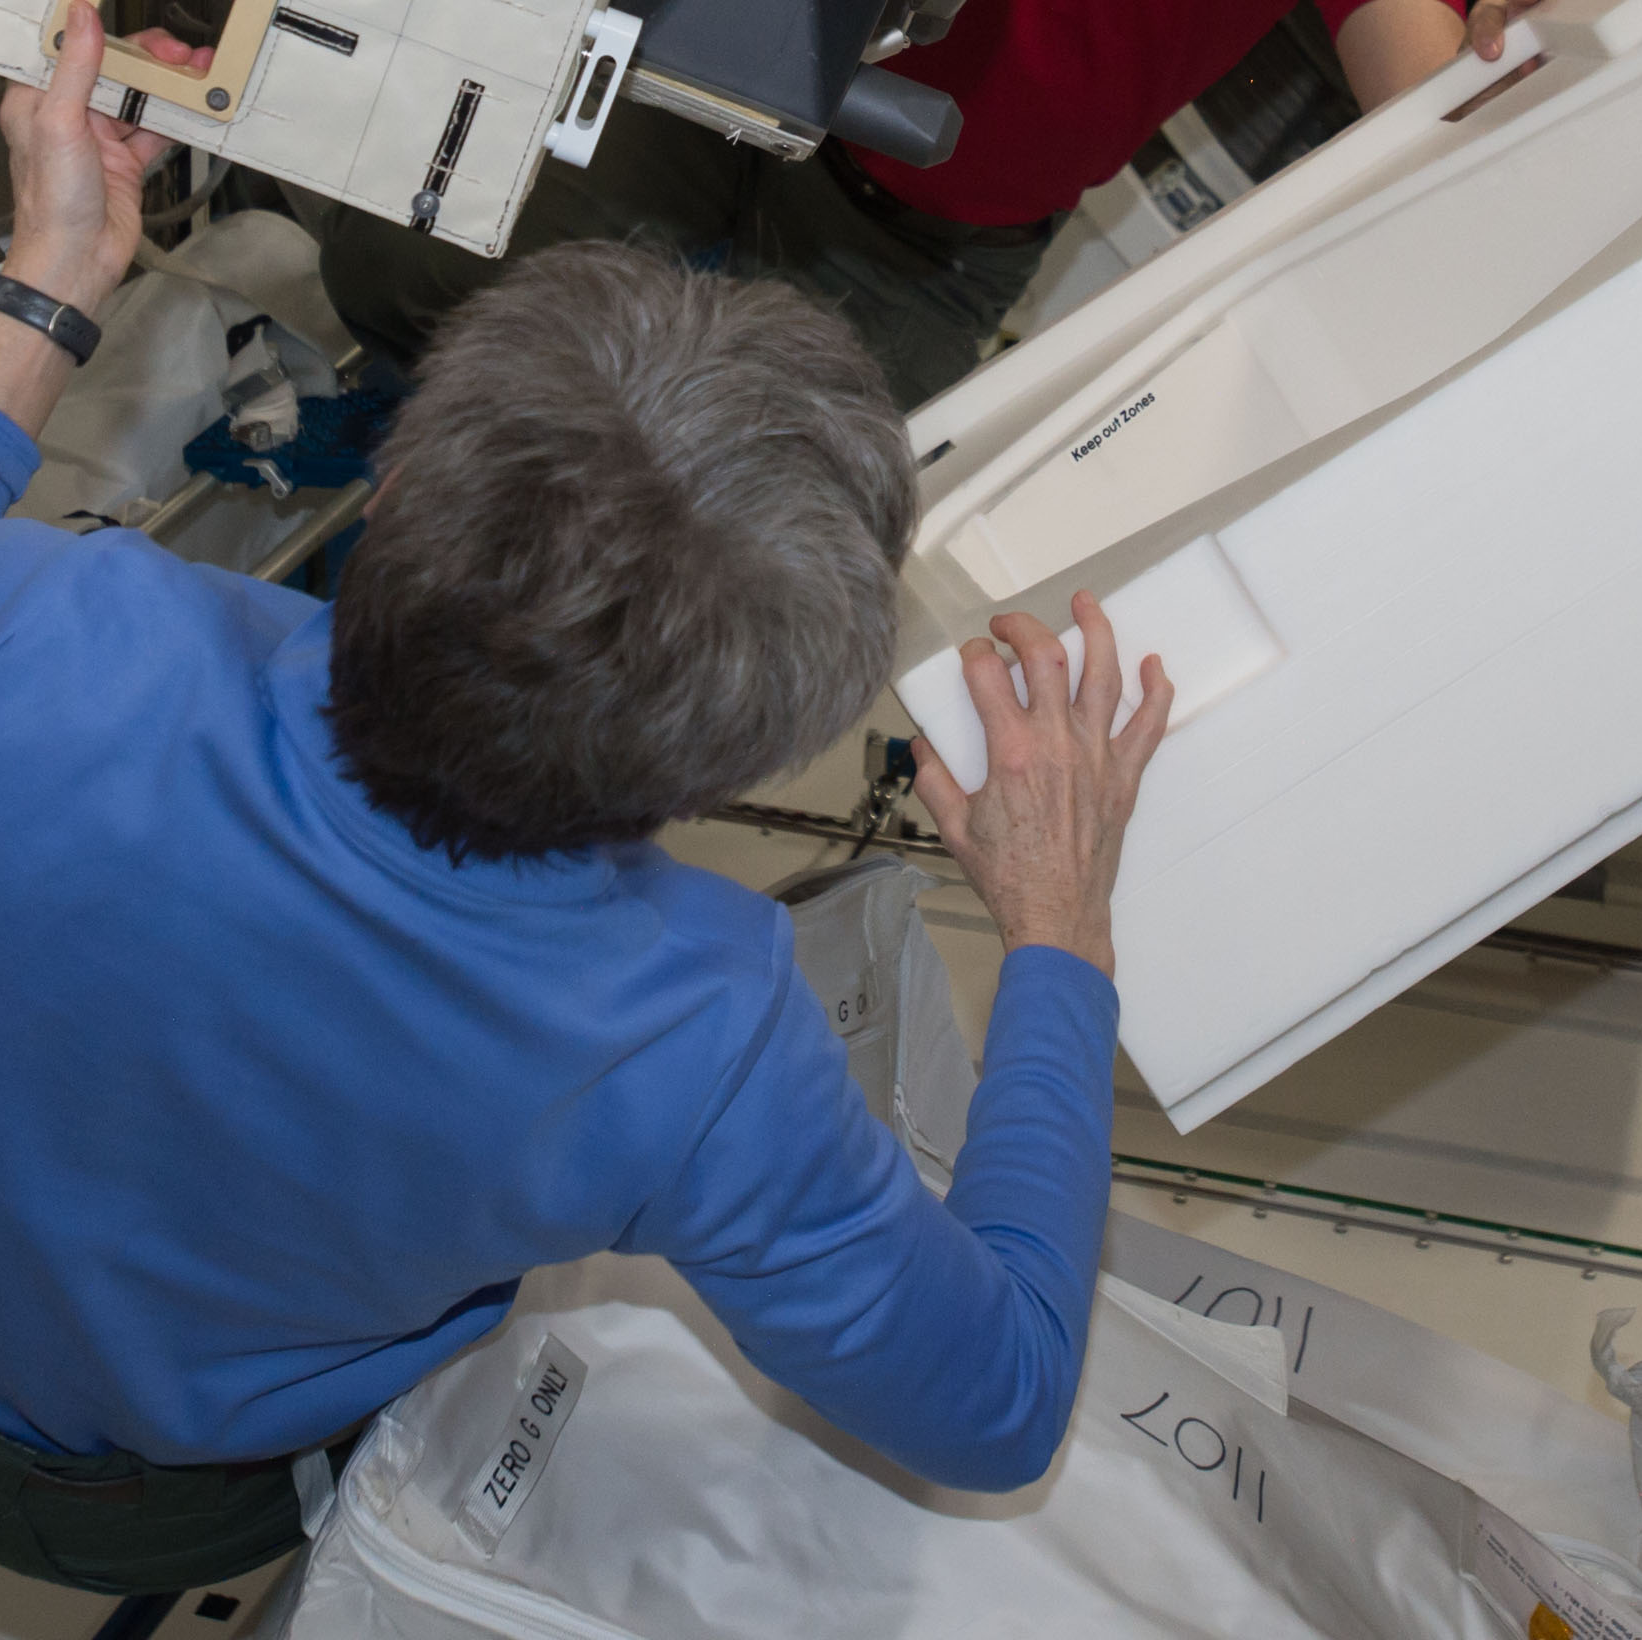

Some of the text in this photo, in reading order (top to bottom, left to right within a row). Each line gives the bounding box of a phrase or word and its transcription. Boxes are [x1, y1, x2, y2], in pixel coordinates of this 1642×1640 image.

[1071, 393, 1155, 462] Keep out Zones
[839, 1000, 848, 1022] G
[483, 1362, 568, 1509] ZERO G ONLY
[1121, 1392, 1265, 1523] 1107
